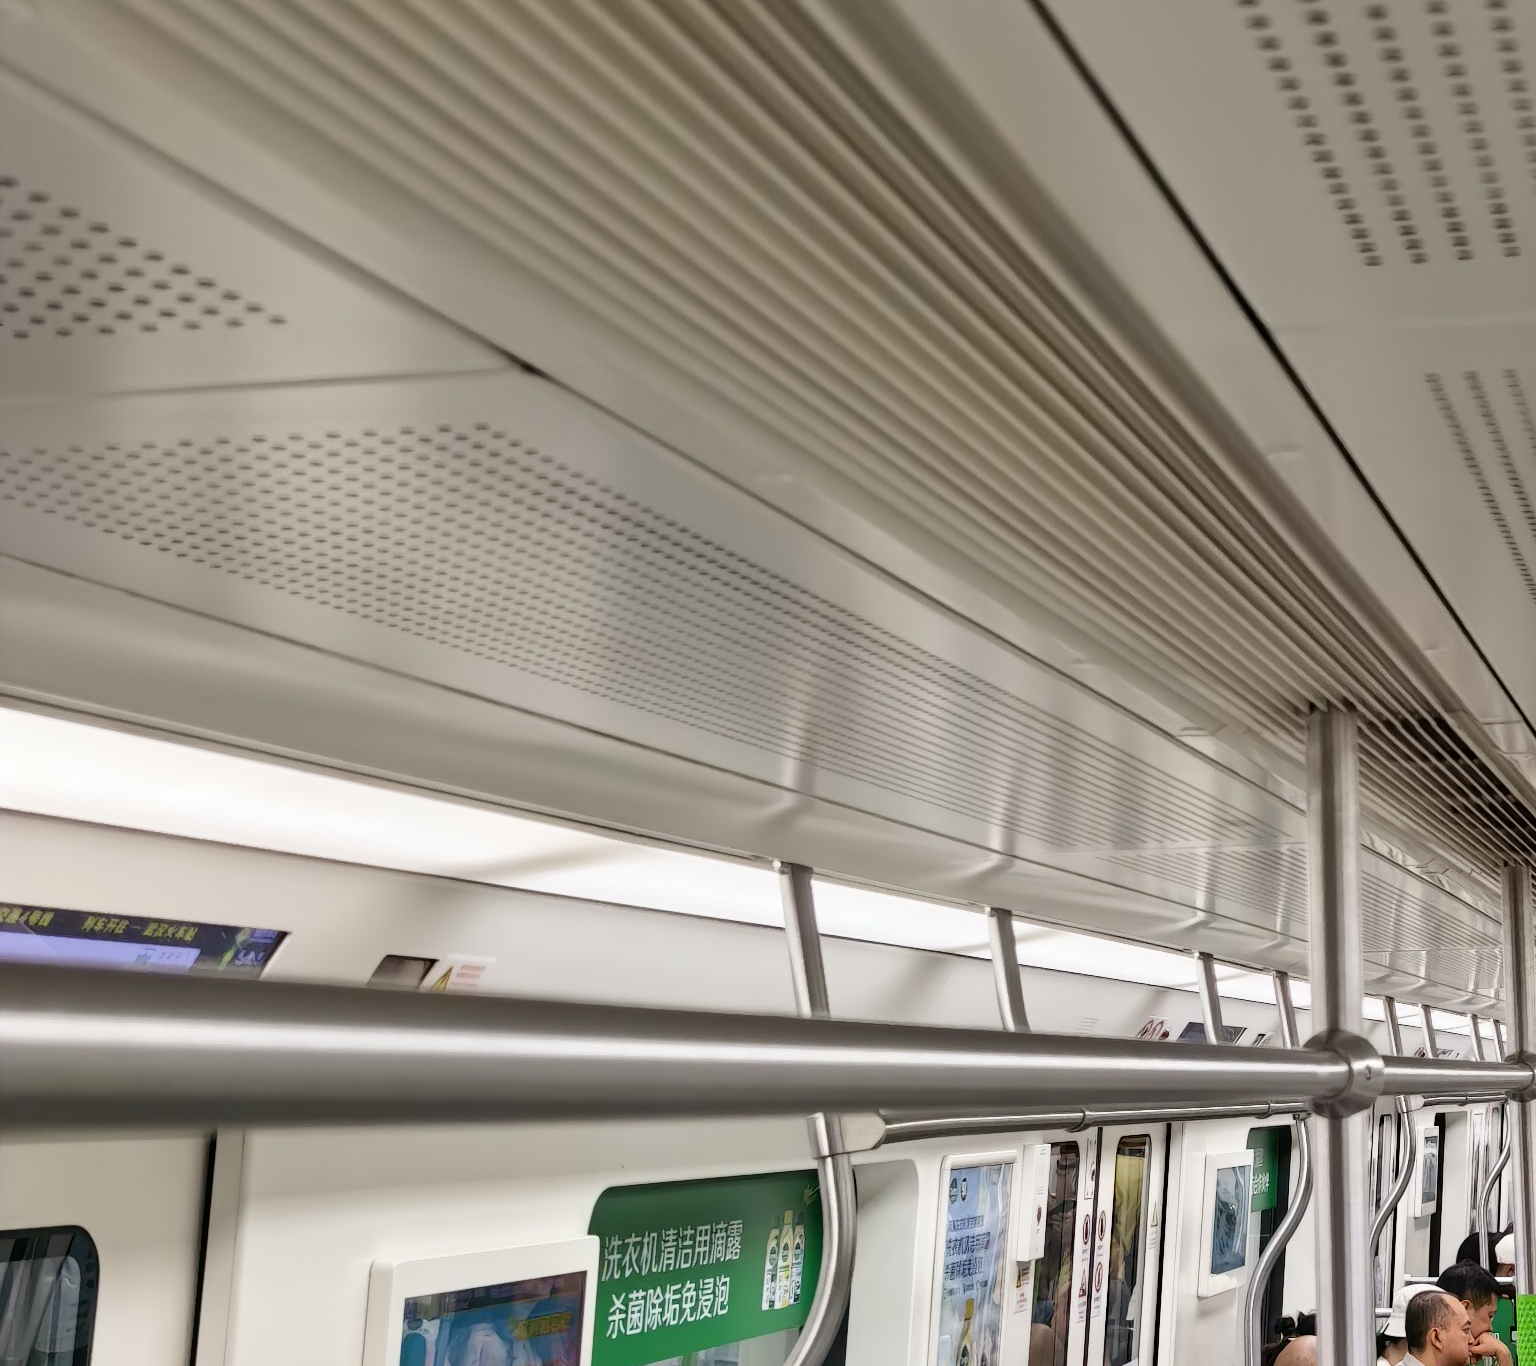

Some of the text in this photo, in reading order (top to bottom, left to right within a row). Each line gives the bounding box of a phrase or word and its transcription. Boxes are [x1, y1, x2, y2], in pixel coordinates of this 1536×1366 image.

[602, 1220, 743, 1282] 洗衣机清洁用滴露
[606, 1274, 731, 1339] 杀菌除垢免浸泡
